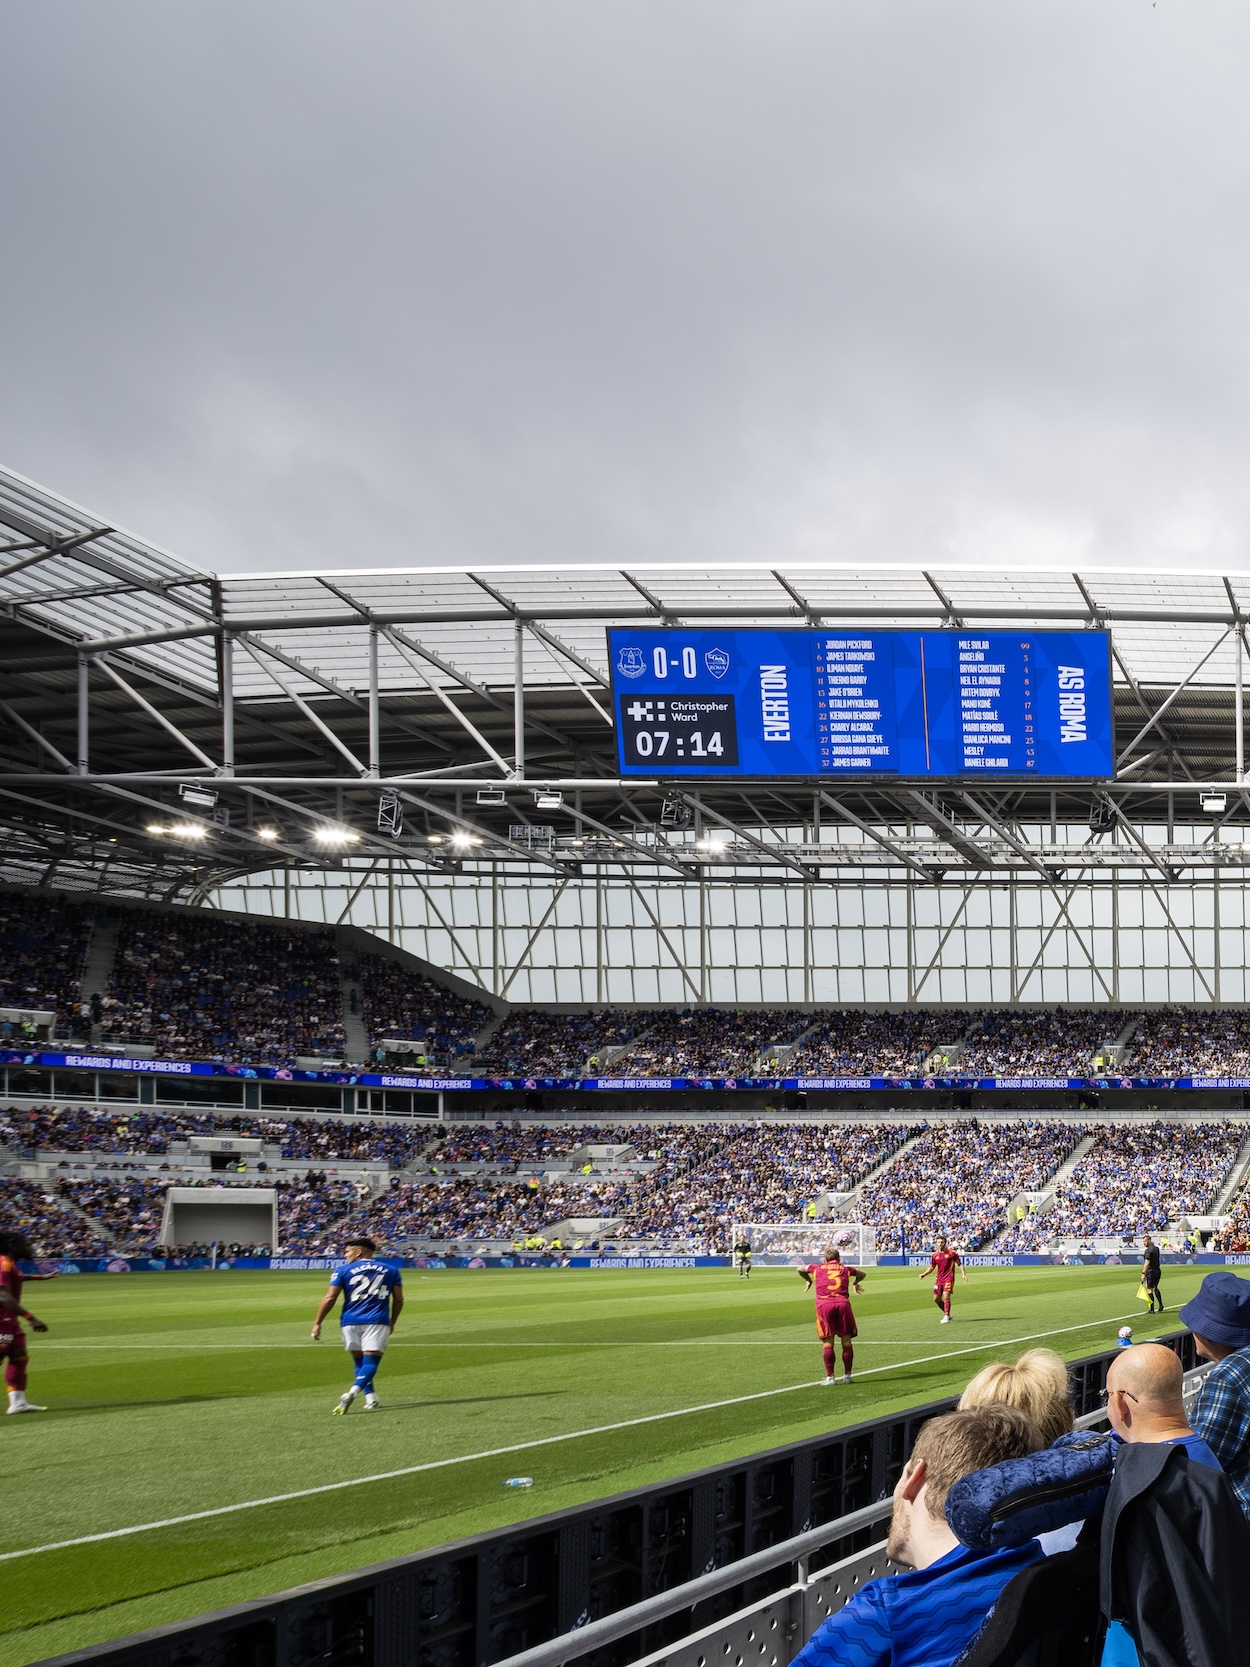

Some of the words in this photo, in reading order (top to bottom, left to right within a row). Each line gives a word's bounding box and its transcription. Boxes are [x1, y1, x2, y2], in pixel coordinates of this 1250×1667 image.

[826, 641, 846, 649] JORDAN
[847, 641, 872, 649] PICKFORD
[959, 641, 970, 650] MILE
[971, 641, 989, 650] SVILAR
[826, 652, 844, 661] JAMES
[845, 652, 875, 661] TARKOWSKI
[846, 664, 864, 673] NDIAYE
[960, 665, 977, 673] BRYAN
[978, 665, 1005, 673] CRISTANTE
[828, 676, 849, 684] THIERNO
[850, 676, 867, 684] BARRY
[960, 676, 971, 685] NEIL
[972, 676, 978, 685] EL
[978, 676, 1001, 685] AYNAOUI
[1058, 666, 1084, 690] AS
[828, 688, 842, 696] JAKE
[961, 688, 978, 697] ARTEM
[979, 688, 1000, 697] DOVBYK
[671, 702, 728, 712] Christopher
[760, 665, 791, 741] EVERTON
[848, 700, 878, 708] MYKOLENKO
[962, 699, 977, 708] MANU
[671, 713, 698, 722] Ward
[830, 712, 852, 720] KIERNAN
[1059, 693, 1087, 743] ROMA
[830, 723, 850, 731] CHARLY
[850, 723, 873, 731] ALCARAZ
[963, 723, 979, 732] MARIO
[980, 723, 1004, 732] HERMOSO
[831, 735, 851, 743] IDRISSA
[852, 735, 866, 743] GANA
[867, 735, 883, 743] GUEYE
[964, 735, 988, 744] GIANLUCA
[988, 735, 1011, 744] MANCINI
[853, 746, 889, 755] BRANTHWAITE
[964, 747, 984, 756] WESLEY
[833, 758, 850, 767] JAMES
[851, 758, 871, 767] GARNER
[965, 758, 985, 767] DANIELE
[986, 758, 1008, 767] GHILARDI
[66, 1056, 111, 1068] REWARDS
[112, 1059, 132, 1069] AND
[133, 1061, 191, 1073] EXPERIENCES
[382, 1076, 417, 1087] REWARDS
[418, 1079, 433, 1088] AND
[434, 1080, 471, 1089] EXPERIENCES
[598, 1080, 622, 1089] REWARDS
[623, 1080, 634, 1089] AND
[635, 1080, 671, 1089] EXPERIENCES
[798, 1079, 823, 1088] REWARDS
[824, 1079, 835, 1088] AND
[836, 1079, 870, 1088] EXPERIENCES
[996, 1079, 1020, 1088] REWARDS
[1022, 1079, 1033, 1088] AND
[1034, 1079, 1068, 1088] EXPERIENCES
[1192, 1079, 1217, 1088] REWARDS
[1218, 1079, 1229, 1088] AND
[270, 1259, 307, 1269] REWARDS
[308, 1259, 325, 1269] AND
[590, 1258, 626, 1267] REWARDS
[628, 1258, 643, 1267] AND
[645, 1258, 695, 1267] EXPERIENCES
[909, 1257, 932, 1266] REWA
[964, 1257, 1014, 1266] EXPERIENCES
[827, 1270, 842, 1290] 3
[349, 1274, 390, 1302] 24
